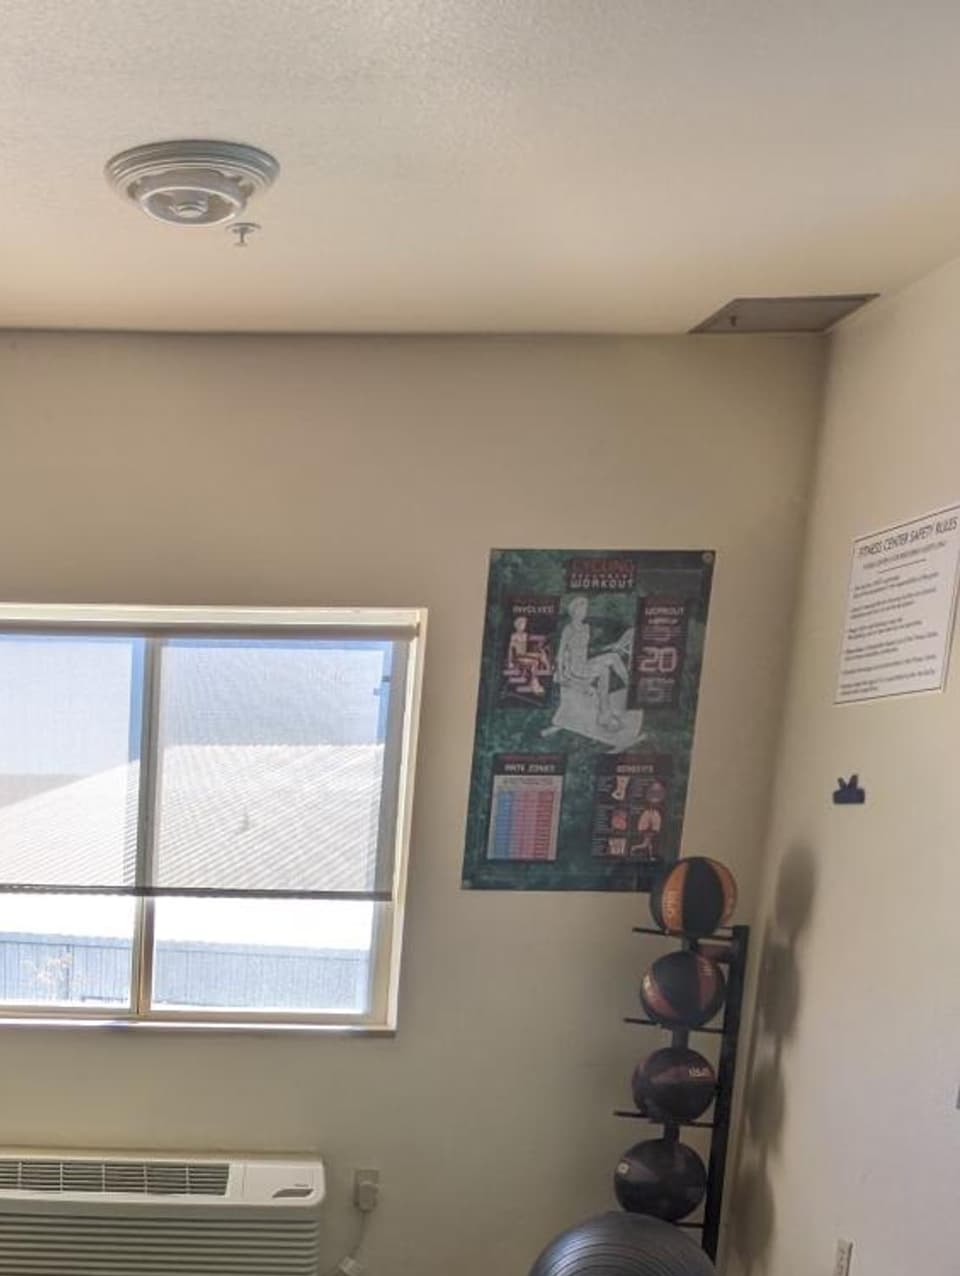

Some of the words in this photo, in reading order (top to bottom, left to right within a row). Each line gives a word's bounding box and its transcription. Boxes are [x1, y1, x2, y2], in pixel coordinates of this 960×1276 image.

[935, 516, 958, 534] RULES
[570, 577, 633, 589] WORKOUT
[639, 646, 678, 672] 20
